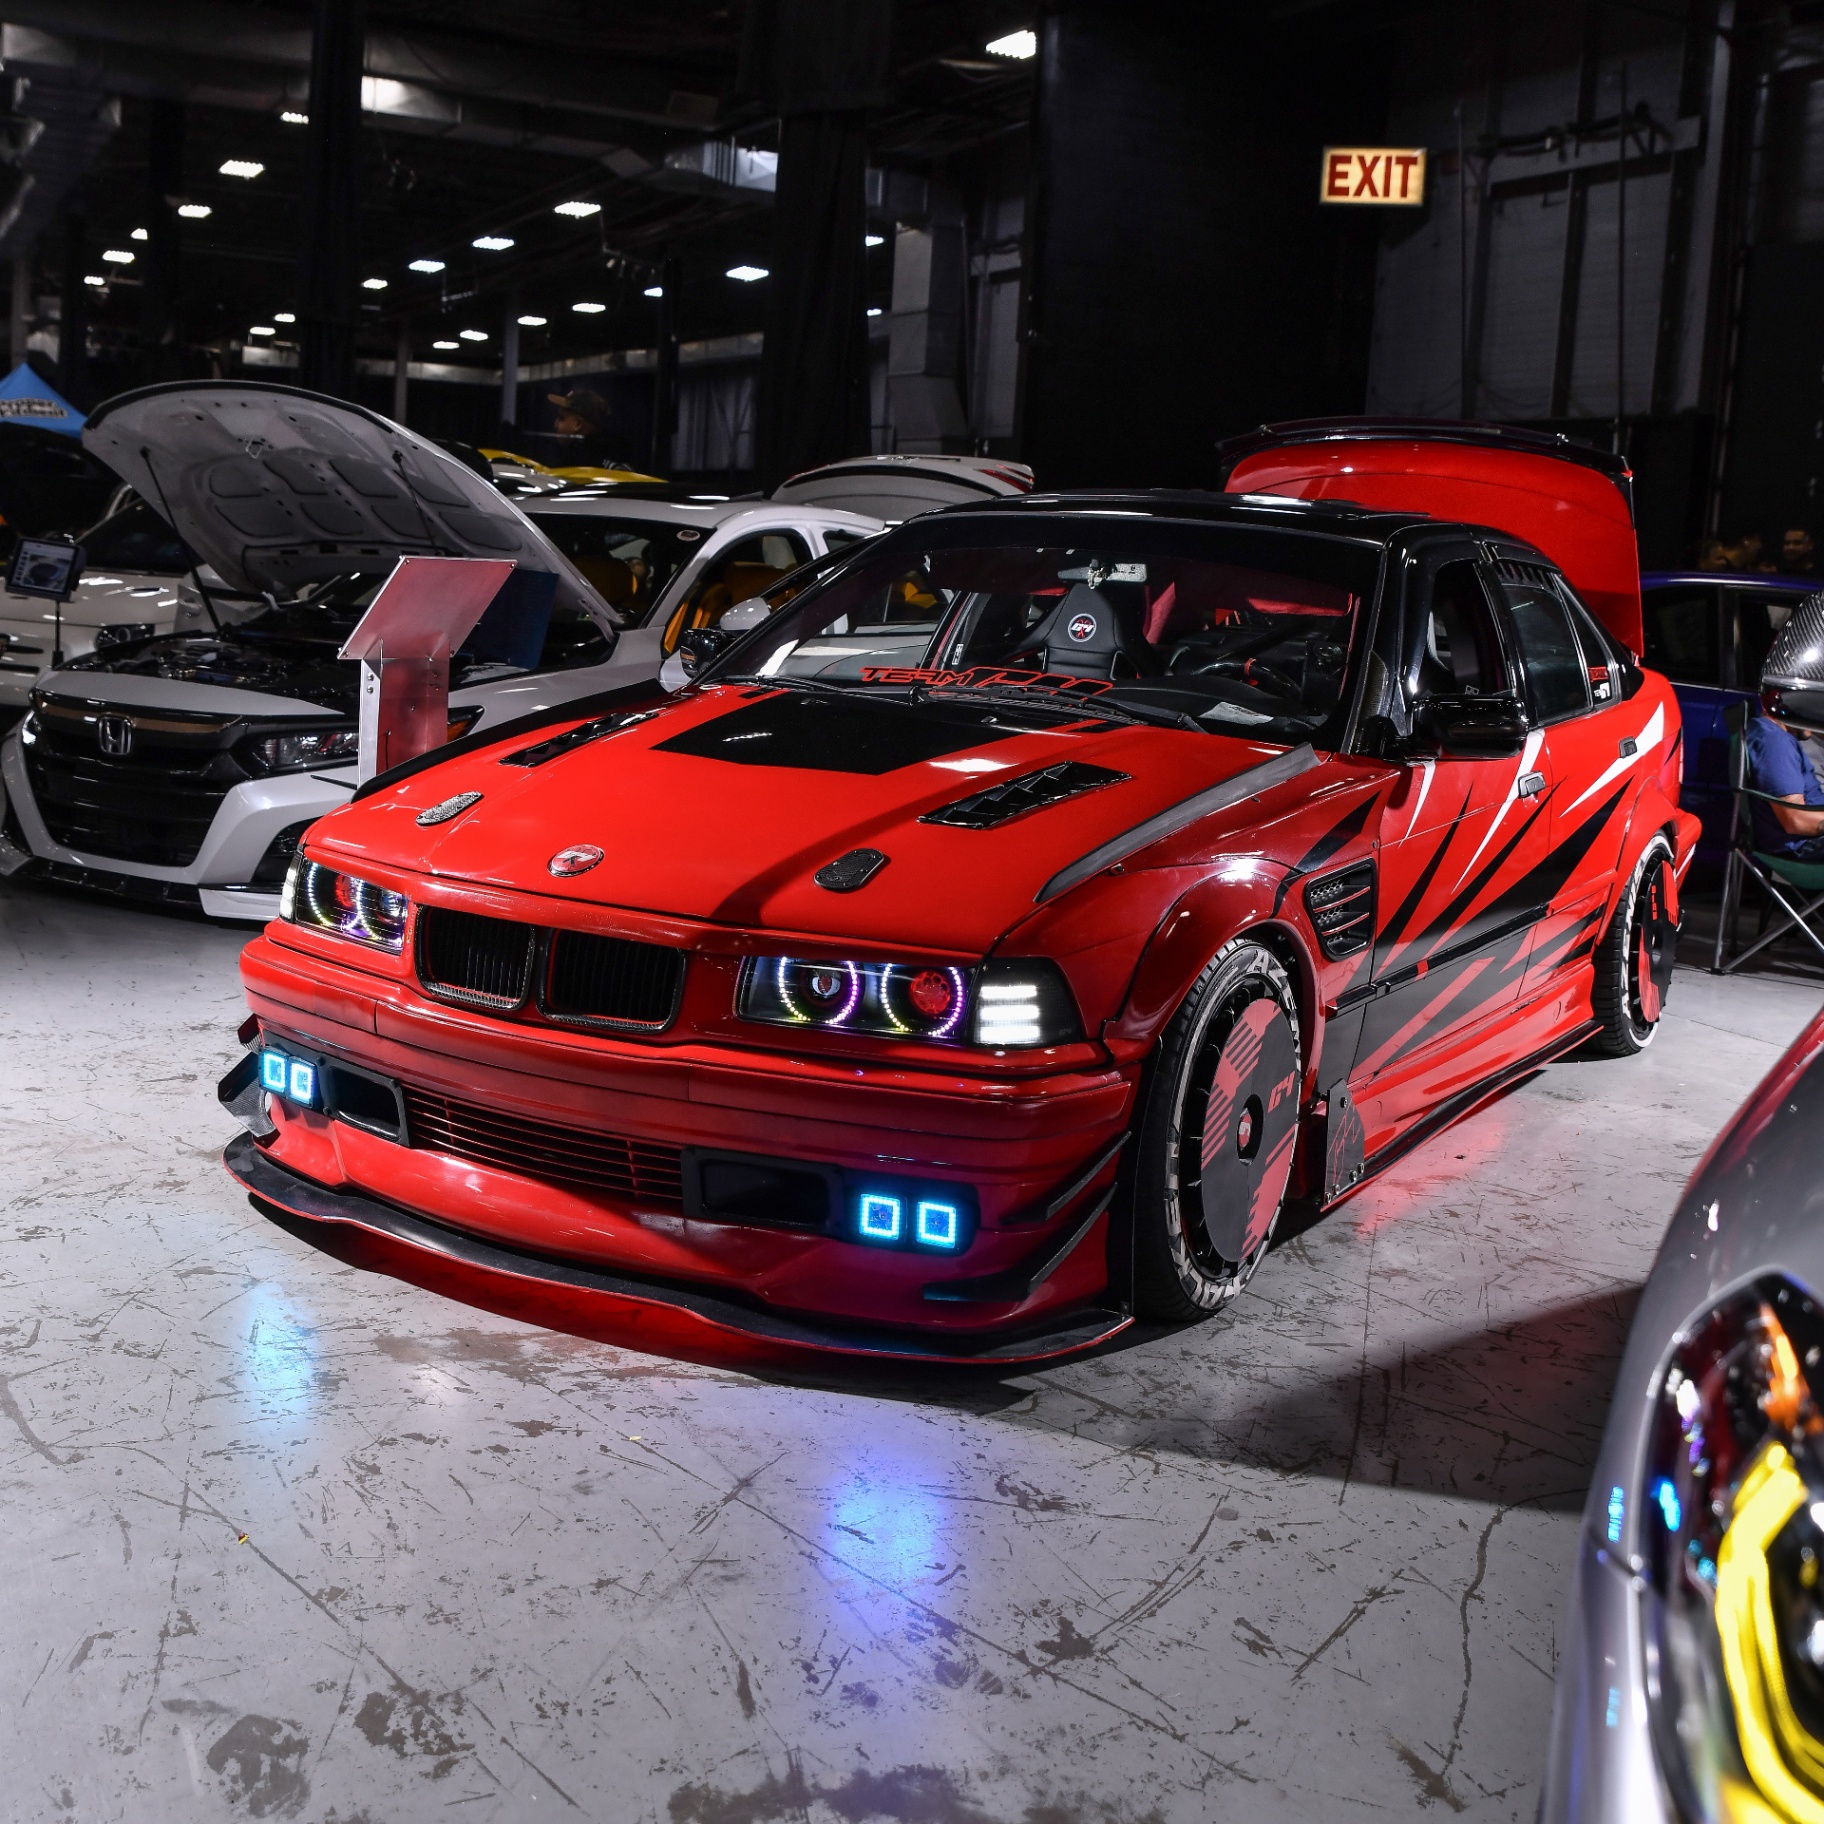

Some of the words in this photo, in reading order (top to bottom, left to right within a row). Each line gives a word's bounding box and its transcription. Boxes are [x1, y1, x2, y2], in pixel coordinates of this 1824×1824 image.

[1327, 154, 1418, 198] EXIT
[860, 666, 975, 687] TEAM
[1165, 1142, 1243, 1310] FALKEN
